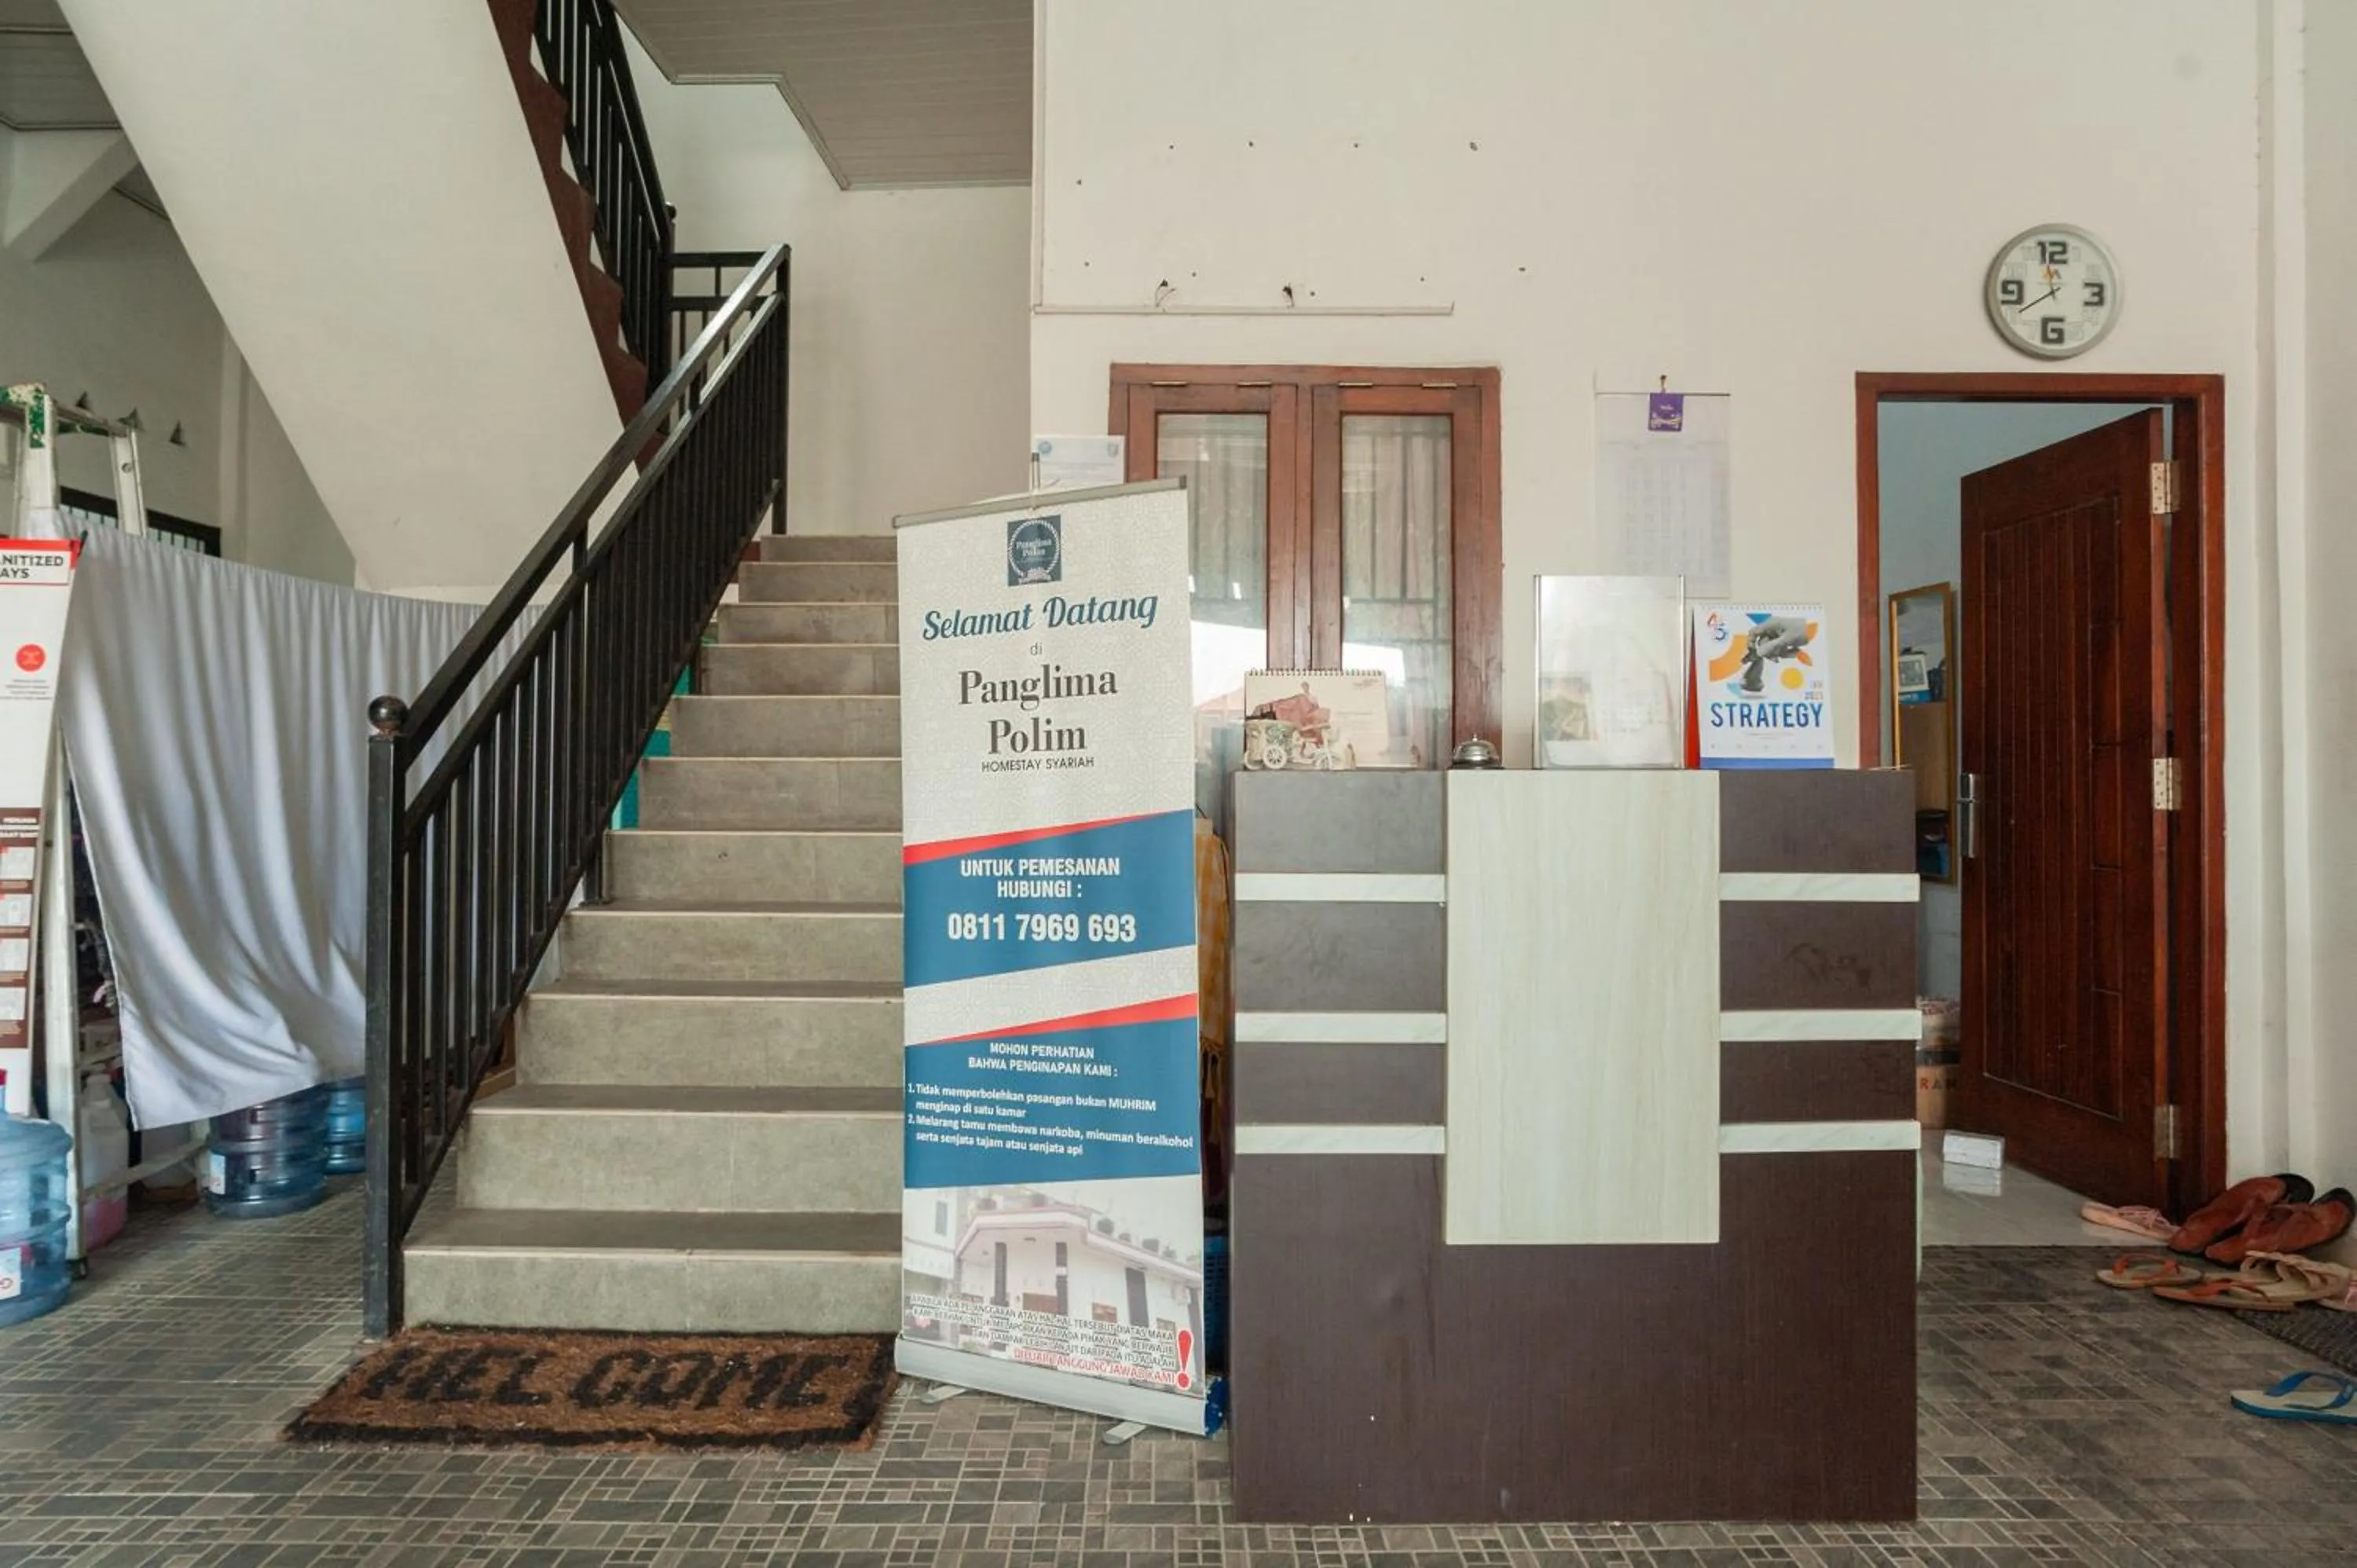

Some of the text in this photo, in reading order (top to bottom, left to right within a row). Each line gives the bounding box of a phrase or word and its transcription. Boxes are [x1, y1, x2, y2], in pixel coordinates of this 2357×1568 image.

[2037, 240, 2068, 265] 12
[2000, 279, 2024, 305] 9
[2084, 282, 2105, 306] 3
[0, 554, 64, 566] NITIZED
[922, 595, 1158, 640] Selamat Datang
[1030, 642, 1043, 656] di
[959, 665, 1117, 710] Panglima
[1710, 702, 1823, 727] STRATEGY
[988, 718, 1086, 754] Polim
[981, 757, 1094, 772] HOMESTAY SYARIAH
[961, 858, 1120, 877] UNTUK PEMESANAN
[997, 881, 1072, 898] HUBUNGI
[948, 913, 1137, 943] 0811 7969 693
[989, 1042, 1094, 1059] MOHON PERHATIAN
[968, 1057, 1007, 1069] BAHWA
[1010, 1059, 1081, 1075] PENGINAPAN
[1083, 1064, 1112, 1076] KAMI
[907, 1083, 1157, 1112] 1. Tidak memperbolehkan pasangan bukan MUHRIM
[915, 1101, 1027, 1117] menginap di satu kamar
[916, 1115, 959, 1130] Melarang
[961, 1119, 986, 1130] tamu
[988, 1122, 1037, 1134] membawa
[1086, 1129, 1134, 1142] minuman
[1136, 1132, 1193, 1148] beralkohol
[916, 1131, 1083, 1157] serta senjata tajam atau senjata api
